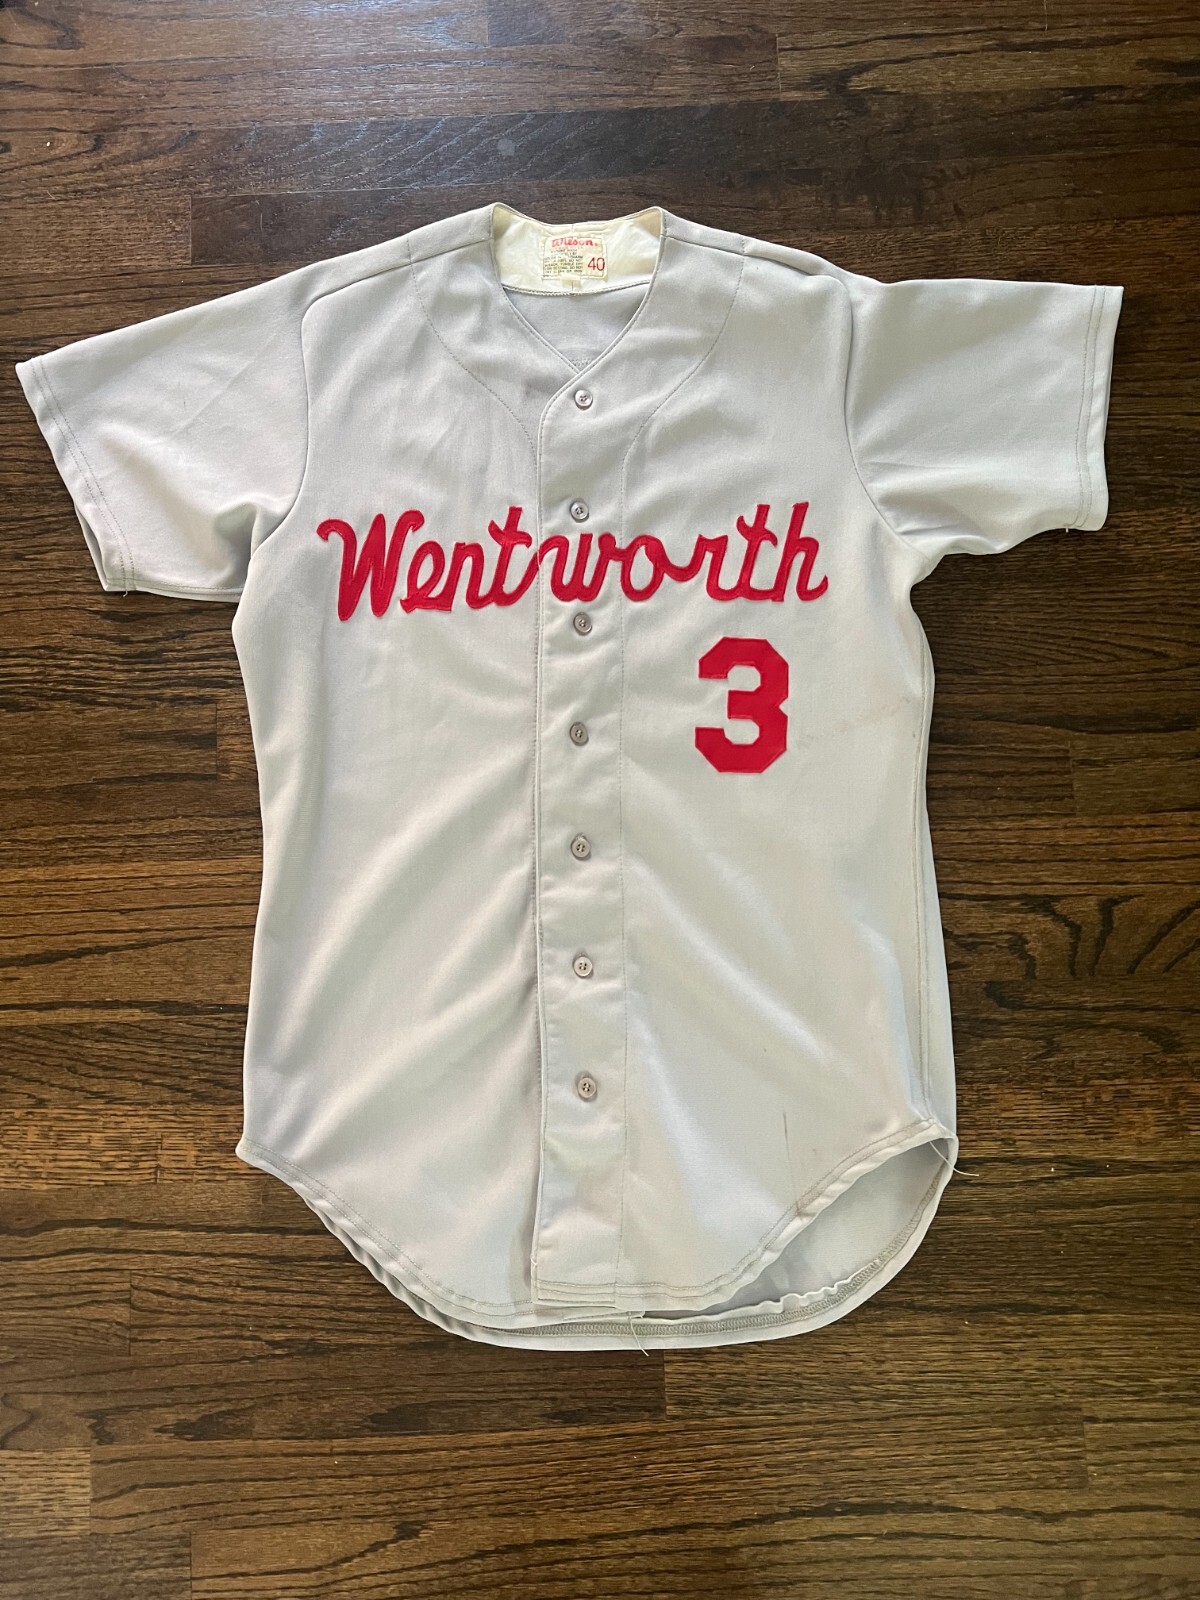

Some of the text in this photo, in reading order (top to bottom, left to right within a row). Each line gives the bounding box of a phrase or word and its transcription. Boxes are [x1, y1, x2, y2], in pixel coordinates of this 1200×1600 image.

[587, 257, 606, 271] 40
[316, 502, 829, 622] Wentworth
[695, 637, 790, 775] 3
